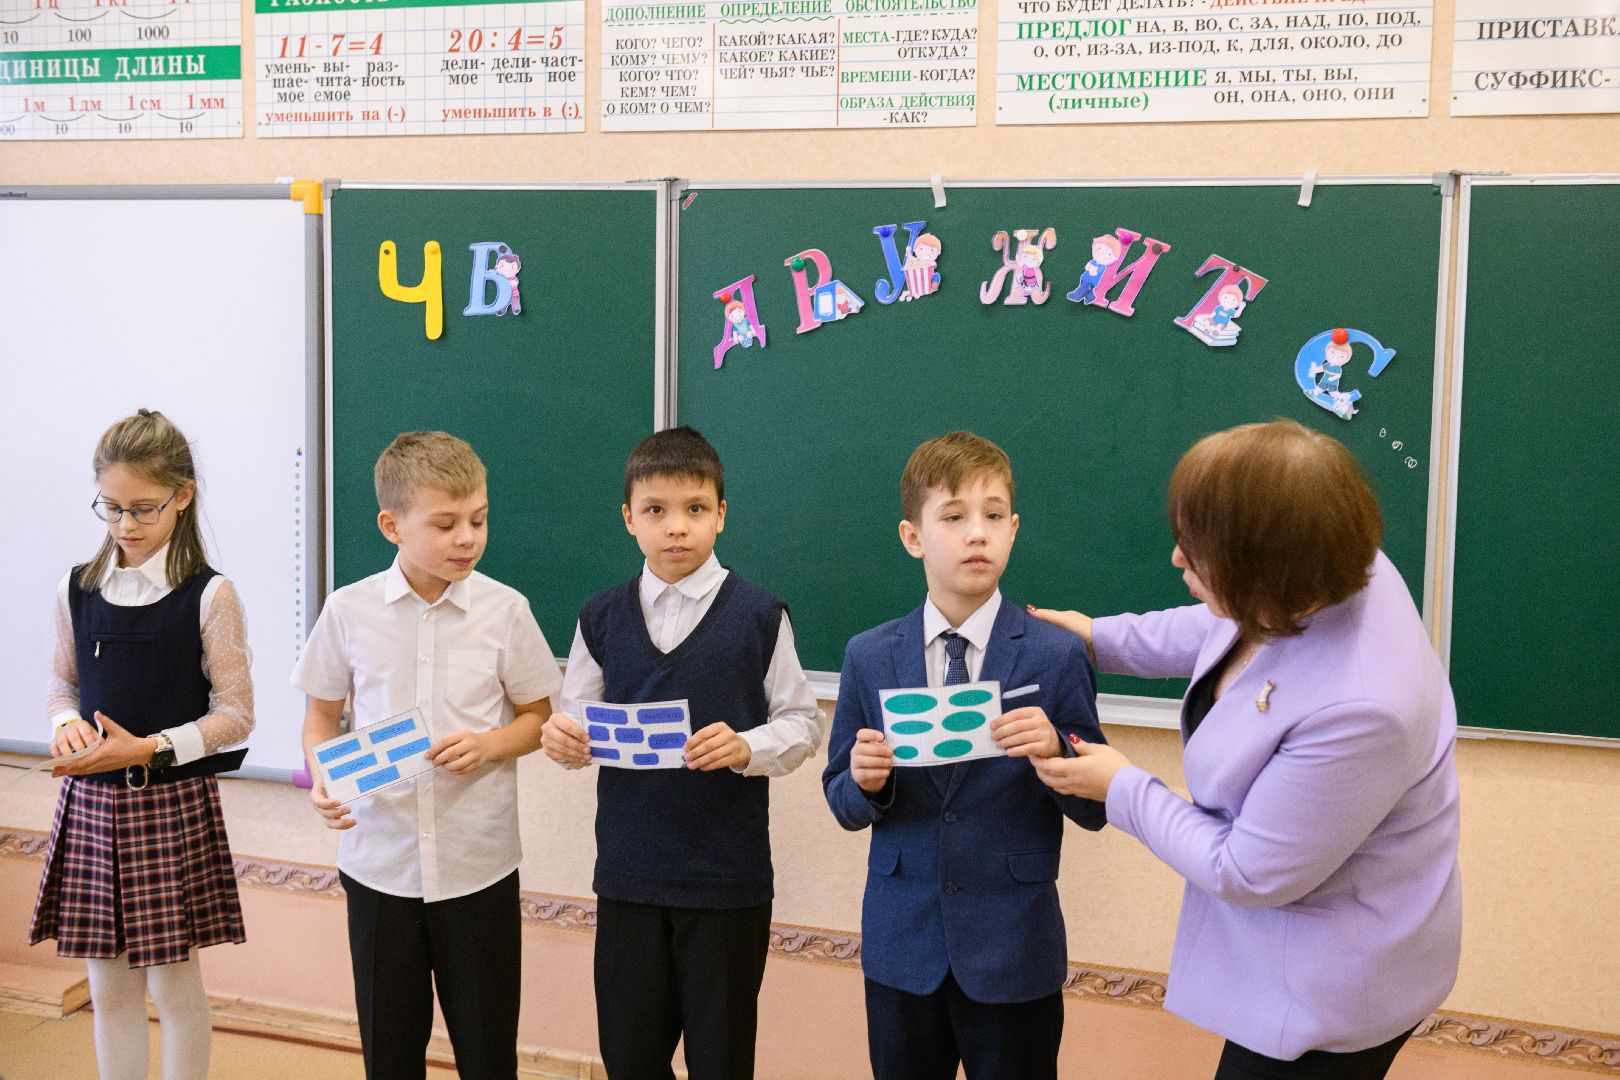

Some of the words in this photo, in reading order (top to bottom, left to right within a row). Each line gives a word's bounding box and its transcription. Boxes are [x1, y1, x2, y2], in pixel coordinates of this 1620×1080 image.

[604, 4, 706, 23] ДОПОЛНЕНИЕ
[720, 0, 832, 17] ОПРЕДЕЛЕНИЕ
[845, 0, 976, 12] ОБСТОЯТЕЛЬСТВО
[1018, 1, 1050, 14] ЧТО
[1056, 0, 1109, 13] БУДЕТ
[137, 26, 169, 40] 1000
[1016, 18, 1132, 41] ПРЕДЛОГ
[1135, 20, 1166, 35] НА,
[1173, 20, 1188, 33] В,
[1195, 18, 1222, 33] ВО,
[1228, 17, 1244, 32] С,
[1250, 16, 1279, 31] ЗА,
[1286, 14, 1331, 30] НАД,
[1338, 12, 1369, 28] ПО,
[1375, 11, 1421, 27] ПОД,
[1477, 17, 1620, 40] ПРИСТАВК
[3, 31, 19, 43] 10
[68, 28, 92, 42] 100
[719, 31, 774, 47] КАКОЙ?
[777, 32, 835, 46] КАКАЯ?
[931, 27, 978, 42] КУДА?
[616, 37, 656, 50] КОГО?
[662, 36, 703, 49] ЧЕГО?
[1033, 45, 1049, 59] О,
[1054, 44, 1081, 58] ОТ,
[1087, 42, 1143, 57] ИЗ-ЗА,
[1149, 39, 1220, 55] ИЗ-ПОД,
[1227, 39, 1243, 53] К,
[1249, 37, 1294, 54] ДЛЯ,
[1300, 34, 1370, 49] ОКОЛО,
[1376, 33, 1403, 49] ДО
[611, 54, 657, 67] КОМУ?
[662, 52, 708, 65] ЧЕМУ?
[719, 50, 774, 64] КАКОЕ?
[778, 49, 835, 63] КАКИЕ?
[897, 45, 968, 60] ОТКУДА?
[115, 54, 206, 80] ДЛИНЫ
[265, 62, 316, 78] умень-
[323, 62, 350, 73] вы-
[367, 60, 399, 76] раз-
[440, 58, 485, 72] дели-
[491, 57, 537, 70] дели-
[540, 55, 583, 68] част-
[448, 73, 478, 85] мое
[496, 72, 533, 84] тель
[547, 70, 576, 83] ное
[619, 69, 660, 82] КОГО?
[665, 68, 699, 81] ЧТО?
[719, 65, 755, 80] ЧЕЙ?
[760, 66, 795, 79] ЧЬЯ?
[800, 65, 835, 78] ЧЬЕ?
[1016, 69, 1208, 91] МЕСТОИМЕНИЕ
[1215, 71, 1232, 85] Я,
[1239, 69, 1276, 84] МЫ,
[1282, 69, 1317, 83] ТЫ,
[1324, 67, 1358, 82] ВЫ,
[272, 78, 308, 88] шае-
[316, 75, 357, 87] чита-
[361, 74, 405, 87] ность
[277, 91, 304, 103] мое
[314, 89, 351, 101] емое
[620, 86, 656, 98] КЕМ?
[661, 85, 697, 97] ЧЕМ?
[606, 103, 616, 114] О
[620, 102, 656, 114] КОМ?
[660, 101, 670, 113] О
[674, 101, 711, 113] ЧЕМ?
[839, 96, 894, 109] ОБРАЗА
[898, 93, 976, 110] ДЕЙСТВИЯ
[1048, 92, 1149, 113] (личные)
[1214, 90, 1244, 105] ОН,
[1251, 89, 1296, 104] ОНА,
[1302, 87, 1347, 102] ОНО,
[1353, 87, 1395, 101] ОНИ
[265, 111, 354, 126] уменьшить
[361, 110, 380, 121] на
[387, 106, 406, 123] (-)
[442, 107, 537, 122] уменьшить
[543, 107, 552, 117] в
[561, 102, 579, 120] (:)
[55, 123, 68, 134] 10
[118, 122, 131, 133] 10
[179, 121, 193, 133] 10
